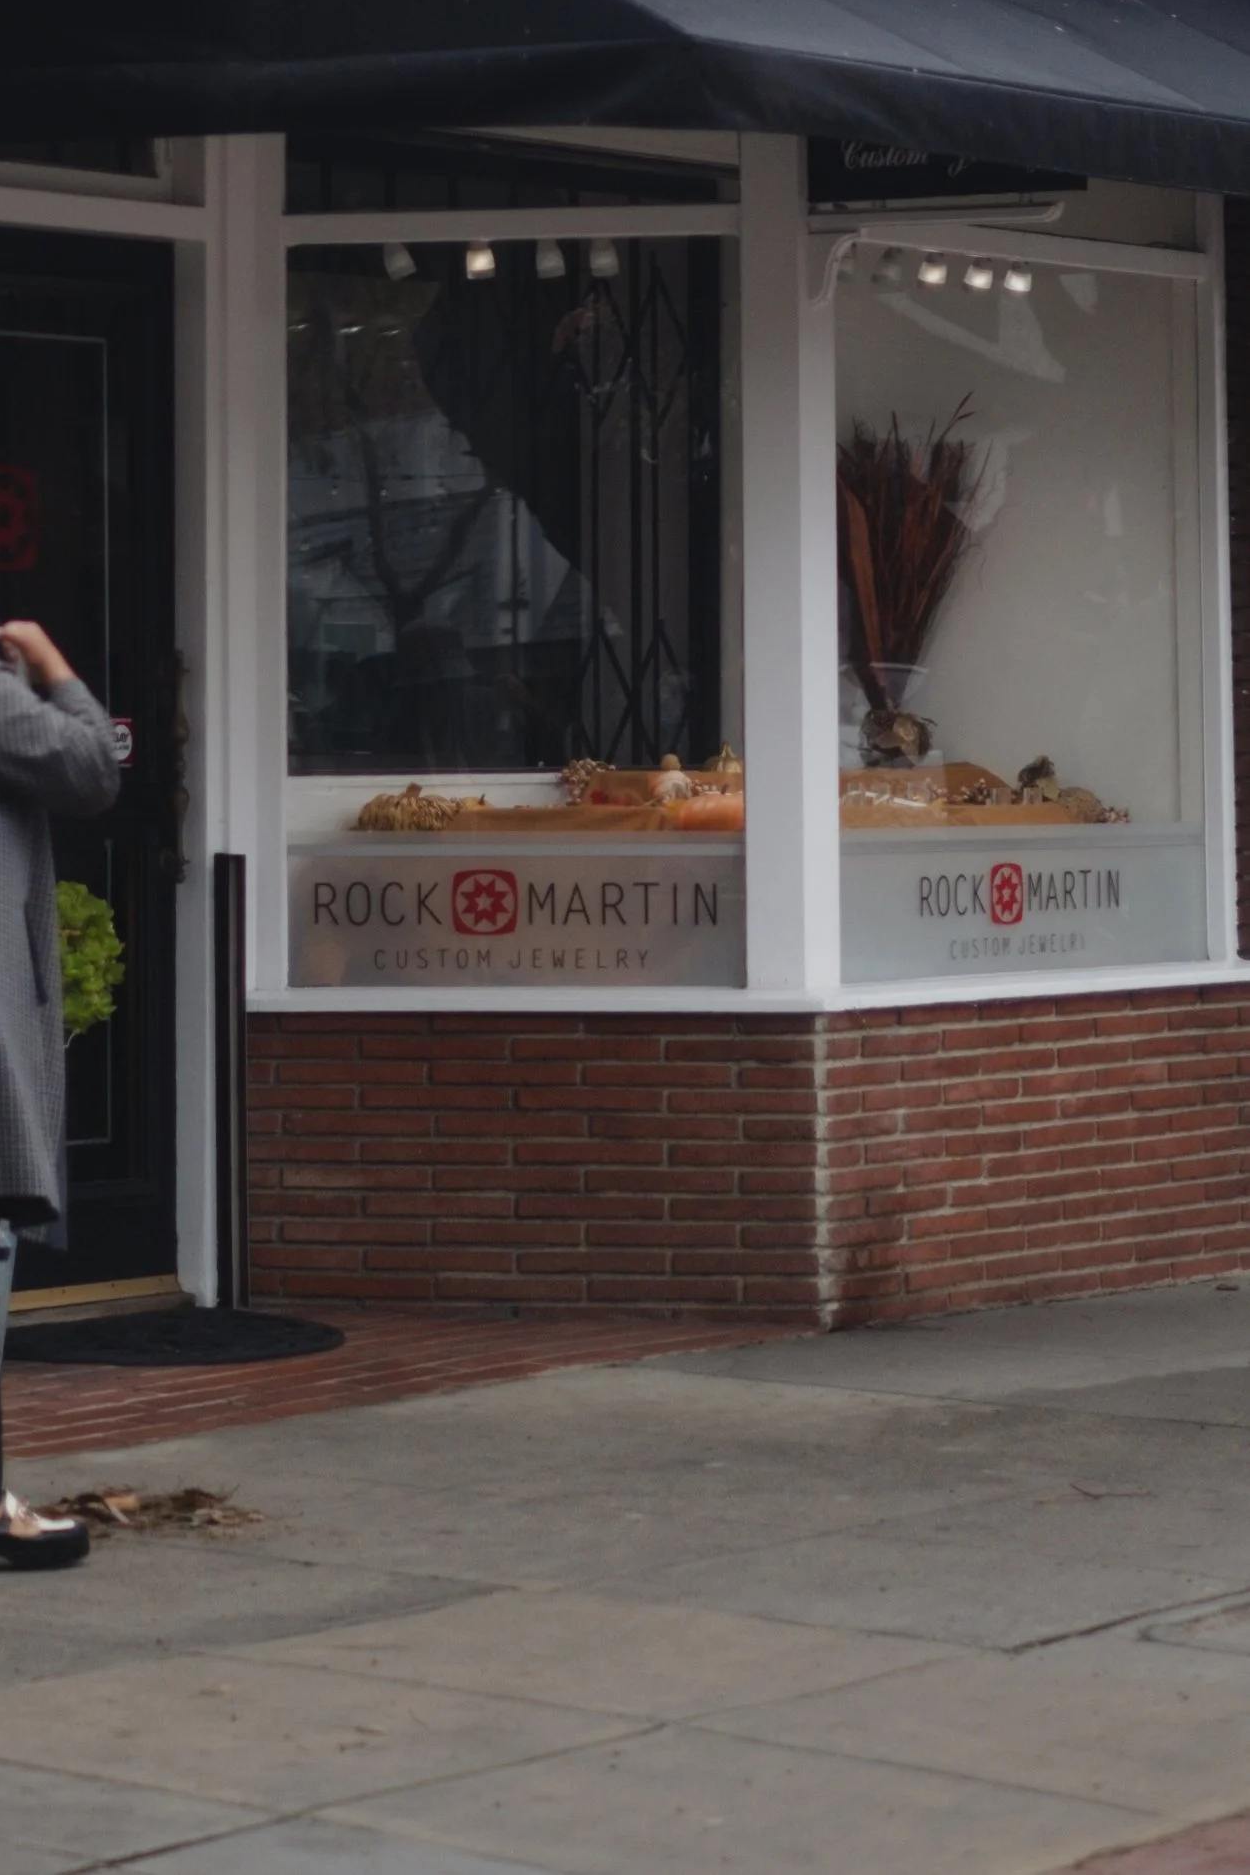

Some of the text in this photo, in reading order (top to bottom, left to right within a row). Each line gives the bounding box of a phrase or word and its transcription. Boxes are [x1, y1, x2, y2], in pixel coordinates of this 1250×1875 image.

[841, 139, 930, 171] Custom
[313, 880, 720, 927] ROCK MARTIN
[920, 870, 1120, 917] ROCK MARTIN
[373, 947, 650, 972] CUSTOM JEWELRY
[950, 937, 1011, 960] CUSTOM
